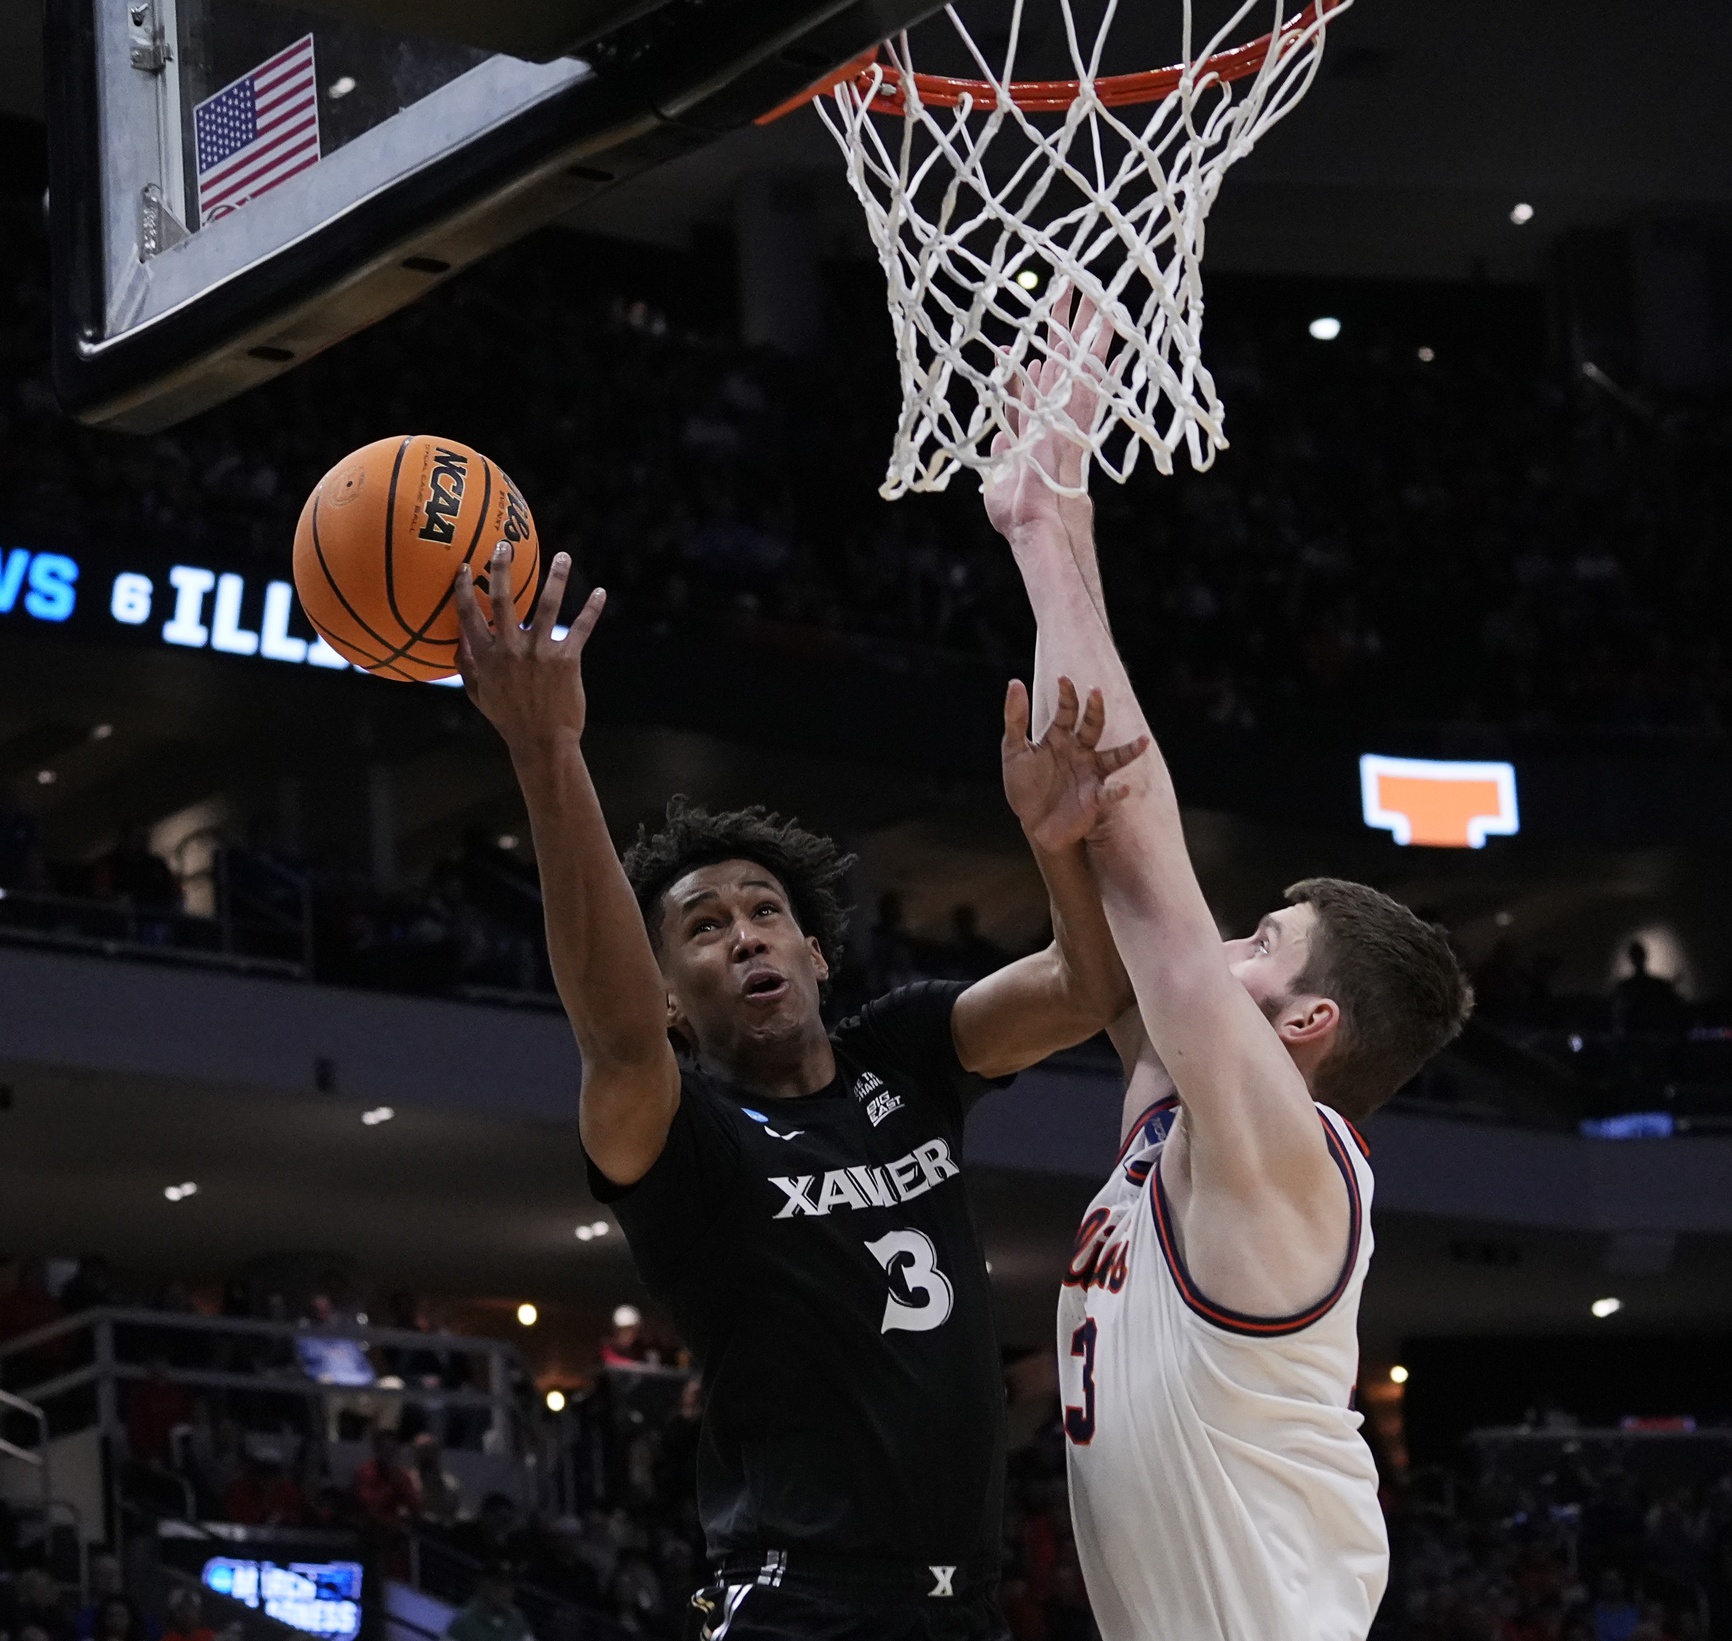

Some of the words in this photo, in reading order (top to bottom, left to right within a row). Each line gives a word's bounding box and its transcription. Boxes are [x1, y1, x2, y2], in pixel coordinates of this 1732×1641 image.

[418, 446, 468, 546] NCAA
[111, 572, 153, 624] 6
[867, 1091, 890, 1116] BIG
[870, 1096, 901, 1123] EAST
[864, 1227, 954, 1334] 3
[928, 1566, 957, 1597] X
